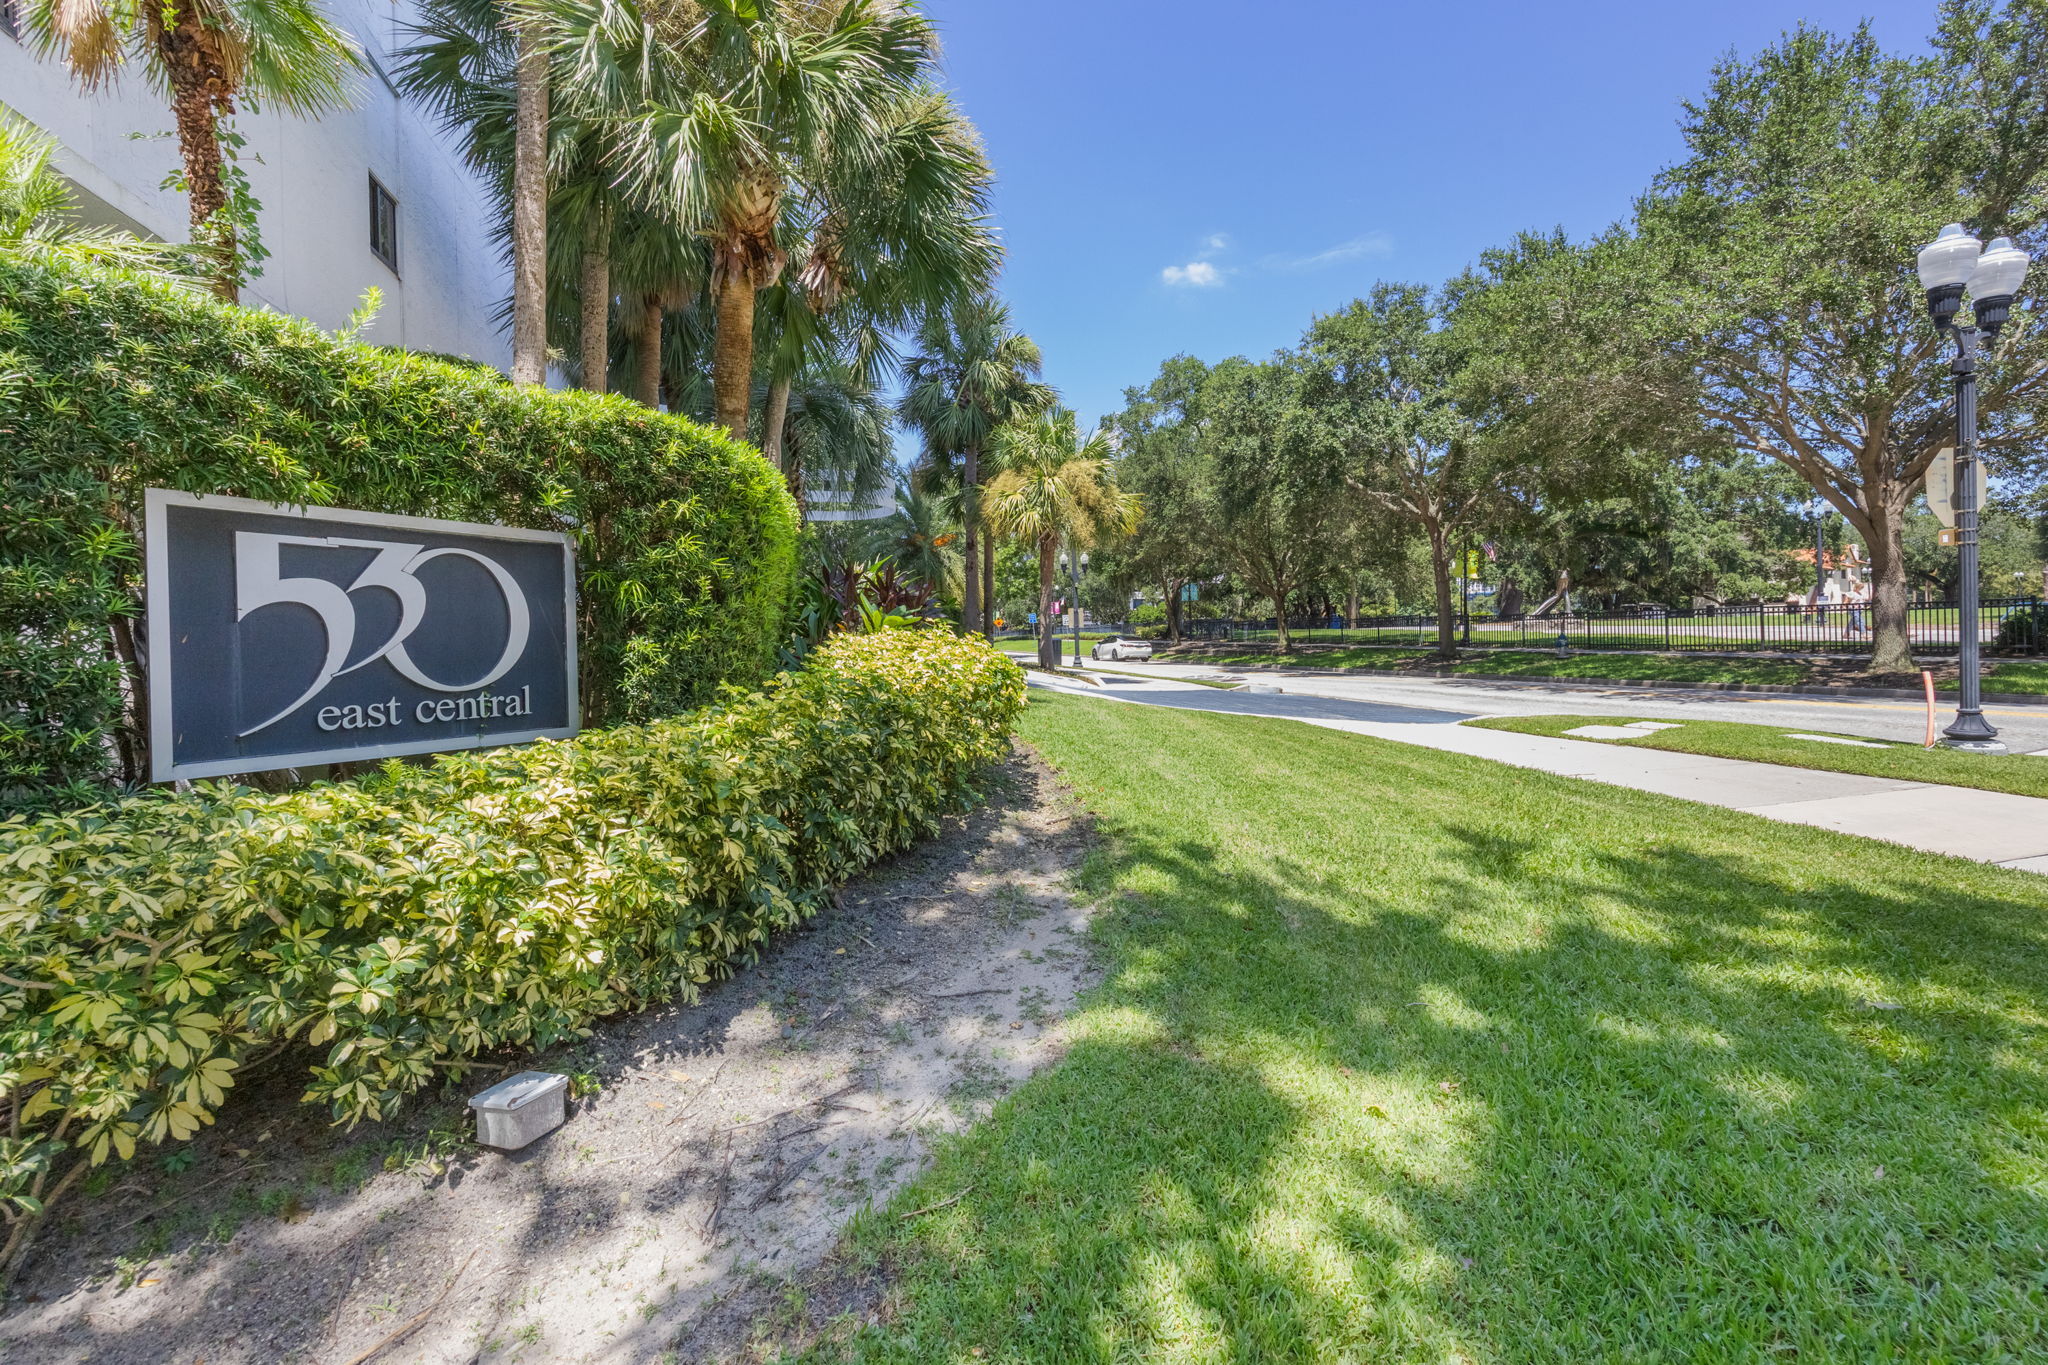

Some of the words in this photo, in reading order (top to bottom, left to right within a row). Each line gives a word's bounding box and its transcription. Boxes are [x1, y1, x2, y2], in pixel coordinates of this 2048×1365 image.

[235, 531, 530, 738] 530
[317, 696, 402, 731] east
[416, 685, 533, 724] central
